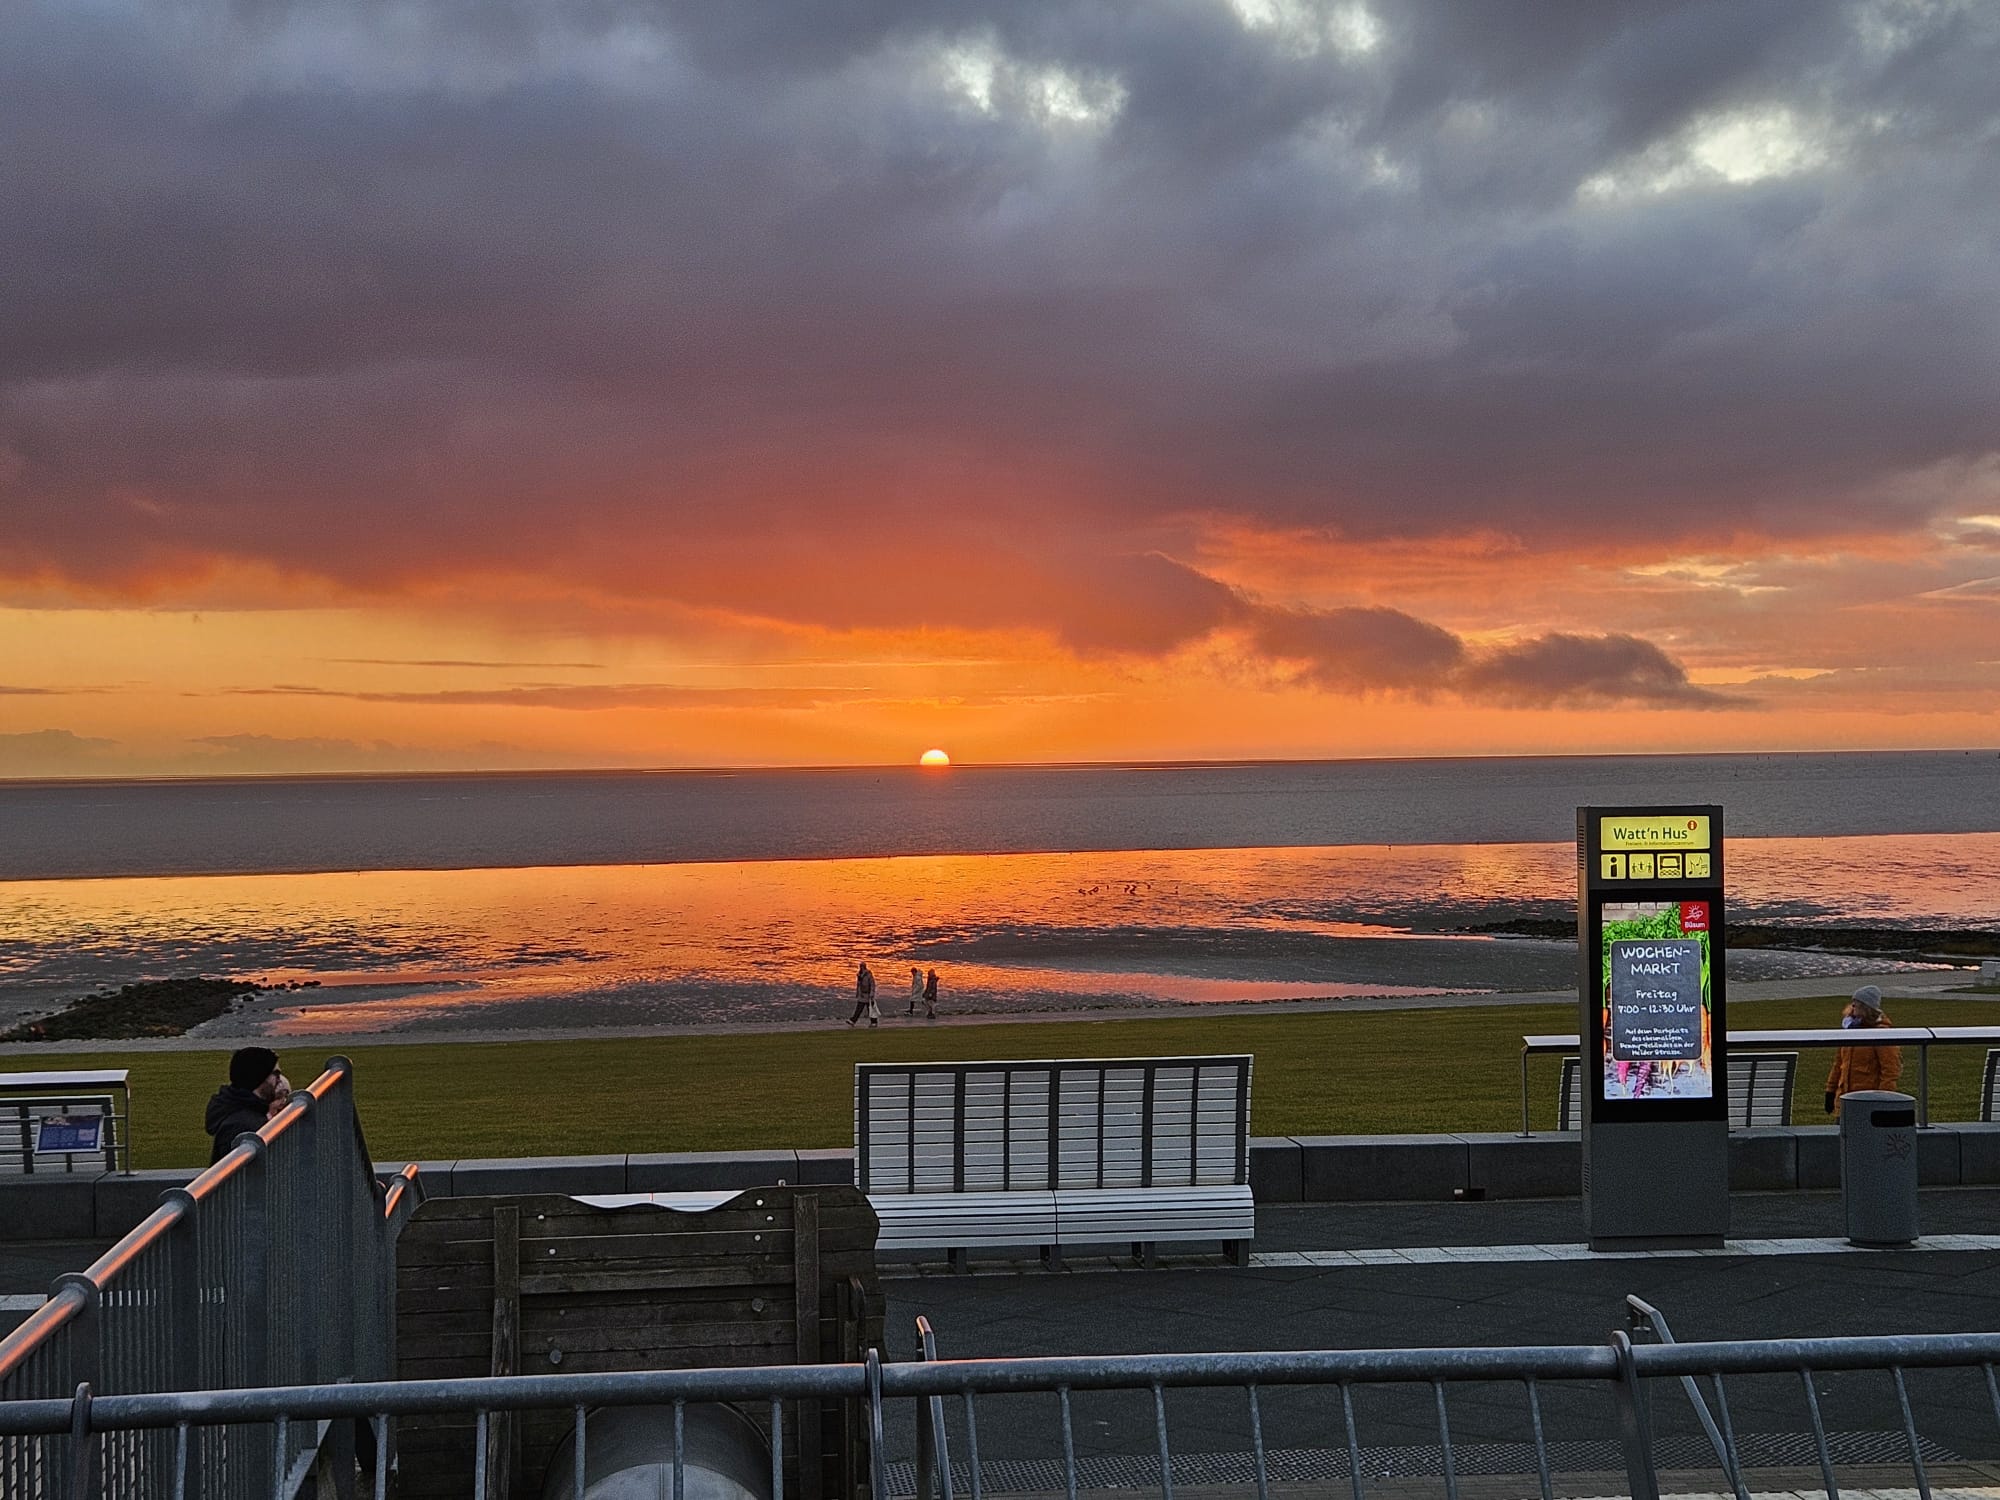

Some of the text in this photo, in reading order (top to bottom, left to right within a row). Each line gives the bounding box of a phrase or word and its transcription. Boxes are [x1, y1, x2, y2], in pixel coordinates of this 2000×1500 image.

[1662, 827, 1688, 839] Hus
[1620, 946, 1691, 959] WOCHEN-
[1630, 962, 1681, 975] MARKT
[1635, 989, 1678, 1000] Freitag
[1617, 1005, 1639, 1014] 7:00
[1648, 1005, 1675, 1013] 12:30
[1676, 1004, 1696, 1013] Uhr
